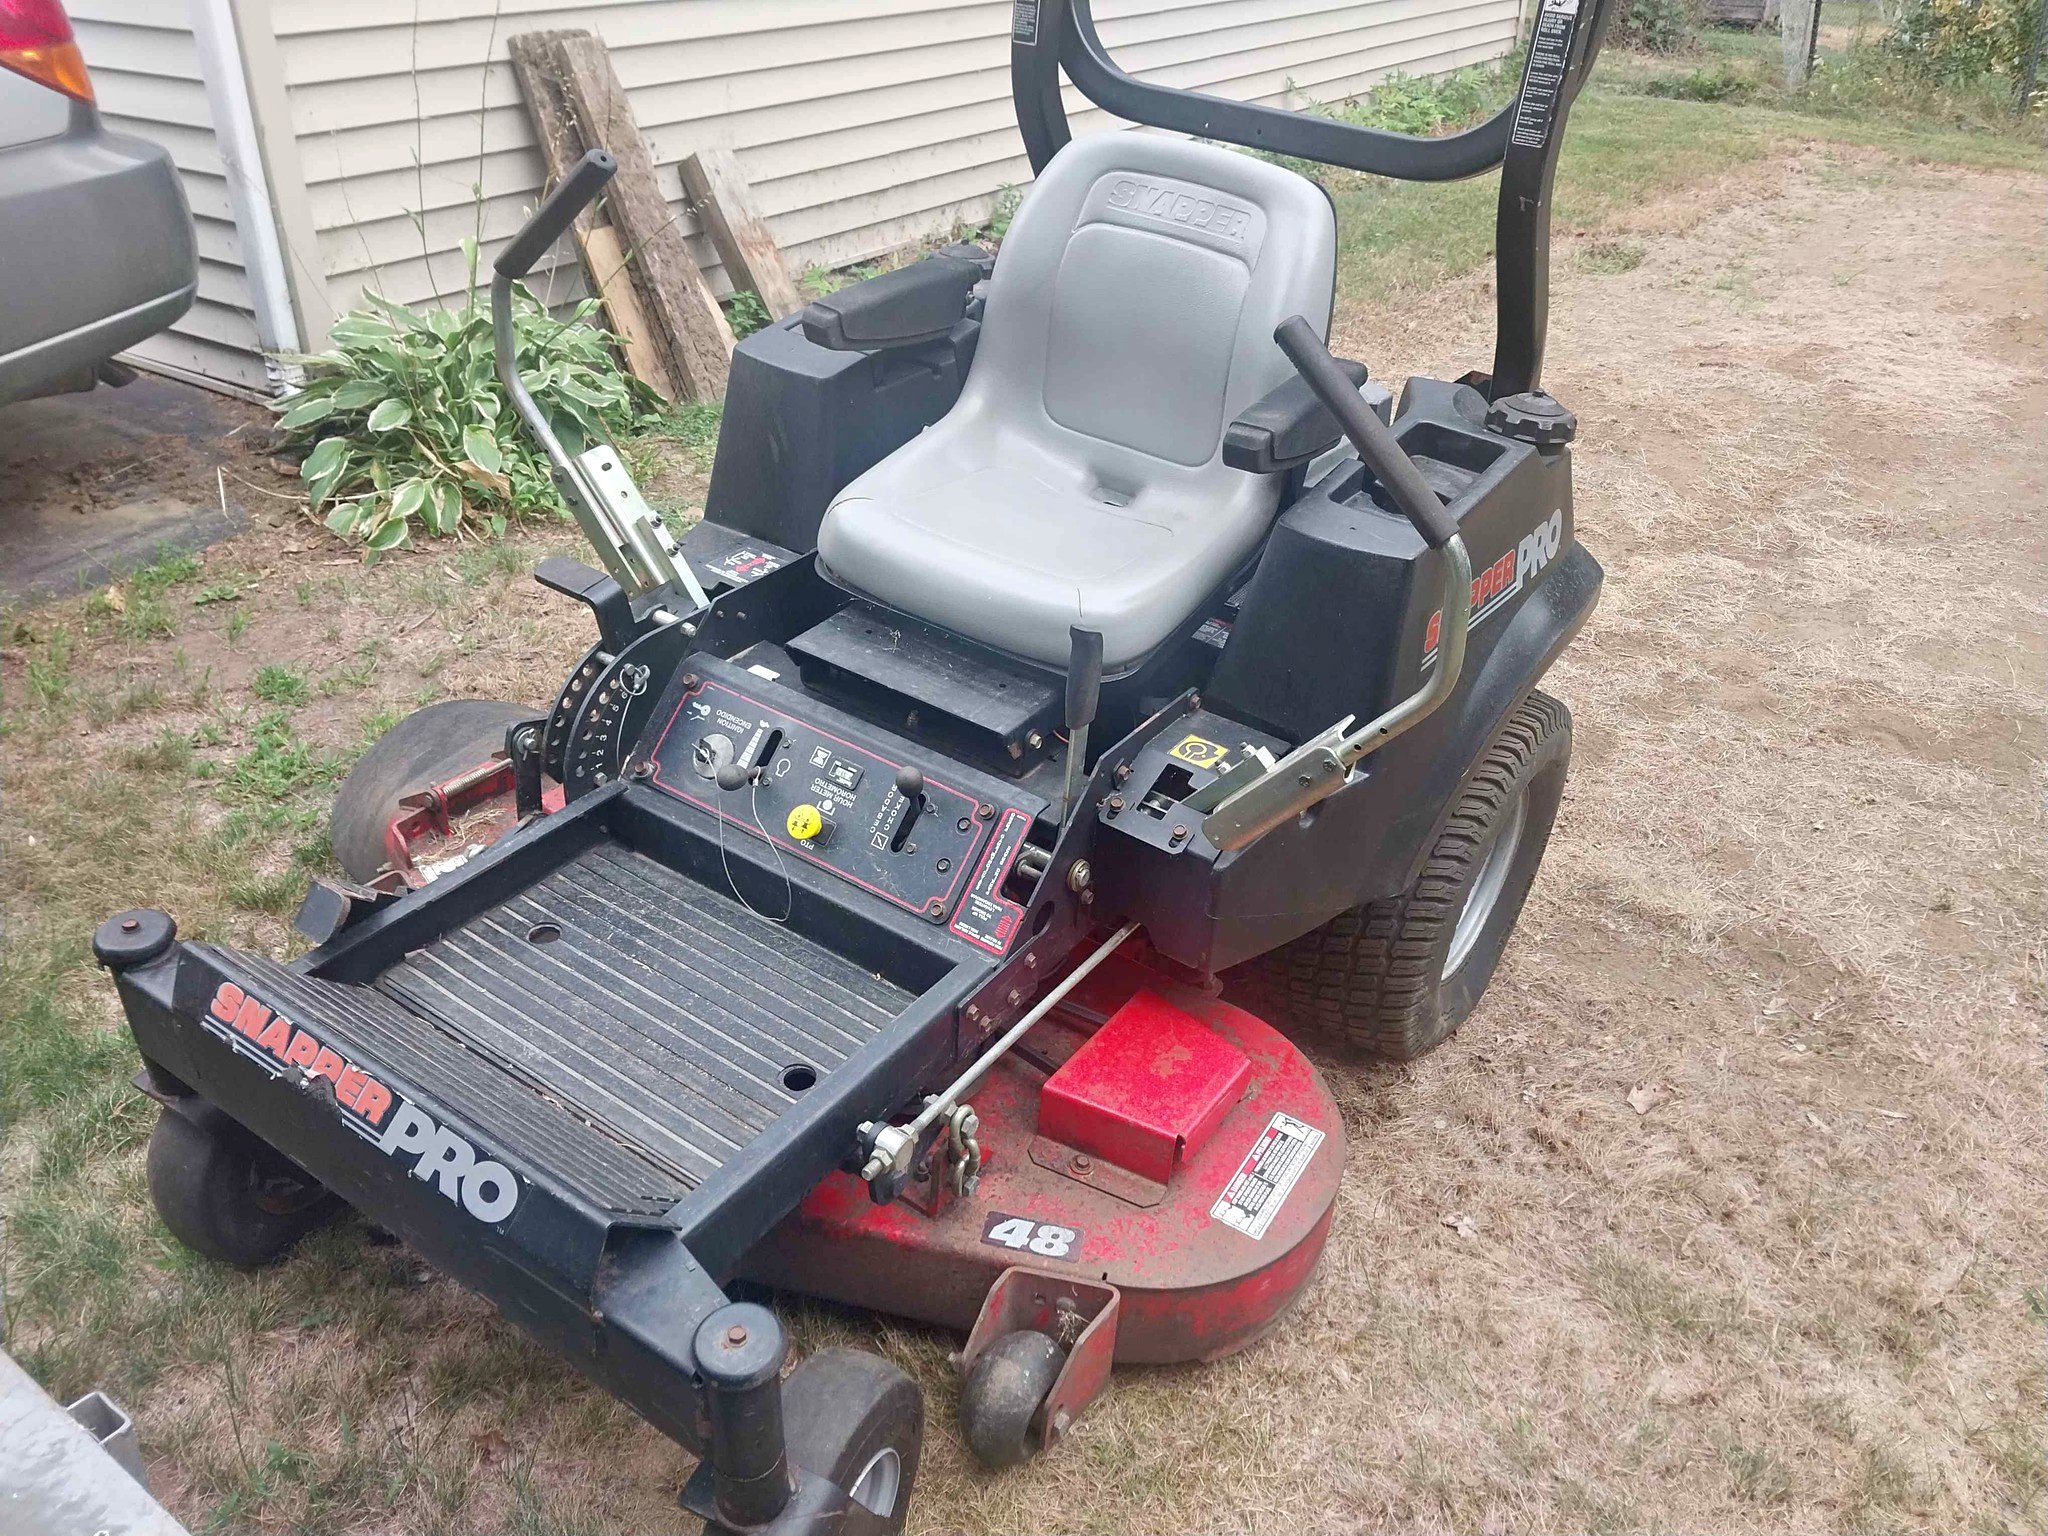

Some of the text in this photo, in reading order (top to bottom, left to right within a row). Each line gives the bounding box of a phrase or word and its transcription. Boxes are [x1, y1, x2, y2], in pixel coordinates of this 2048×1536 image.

[1107, 180, 1251, 241] SNAPPER
[1424, 508, 1563, 654] SPPER PRO
[716, 709, 752, 730] ENCENDIDO
[717, 718, 745, 734] IGNITION
[810, 784, 854, 809] HOUR METER
[870, 784, 898, 833] CEBADOR
[884, 795, 905, 831] CHOKE
[800, 839, 815, 850] PTO
[211, 982, 393, 1126] SNAPPER
[379, 1101, 518, 1223] PRO
[988, 1218, 1076, 1257] 48
